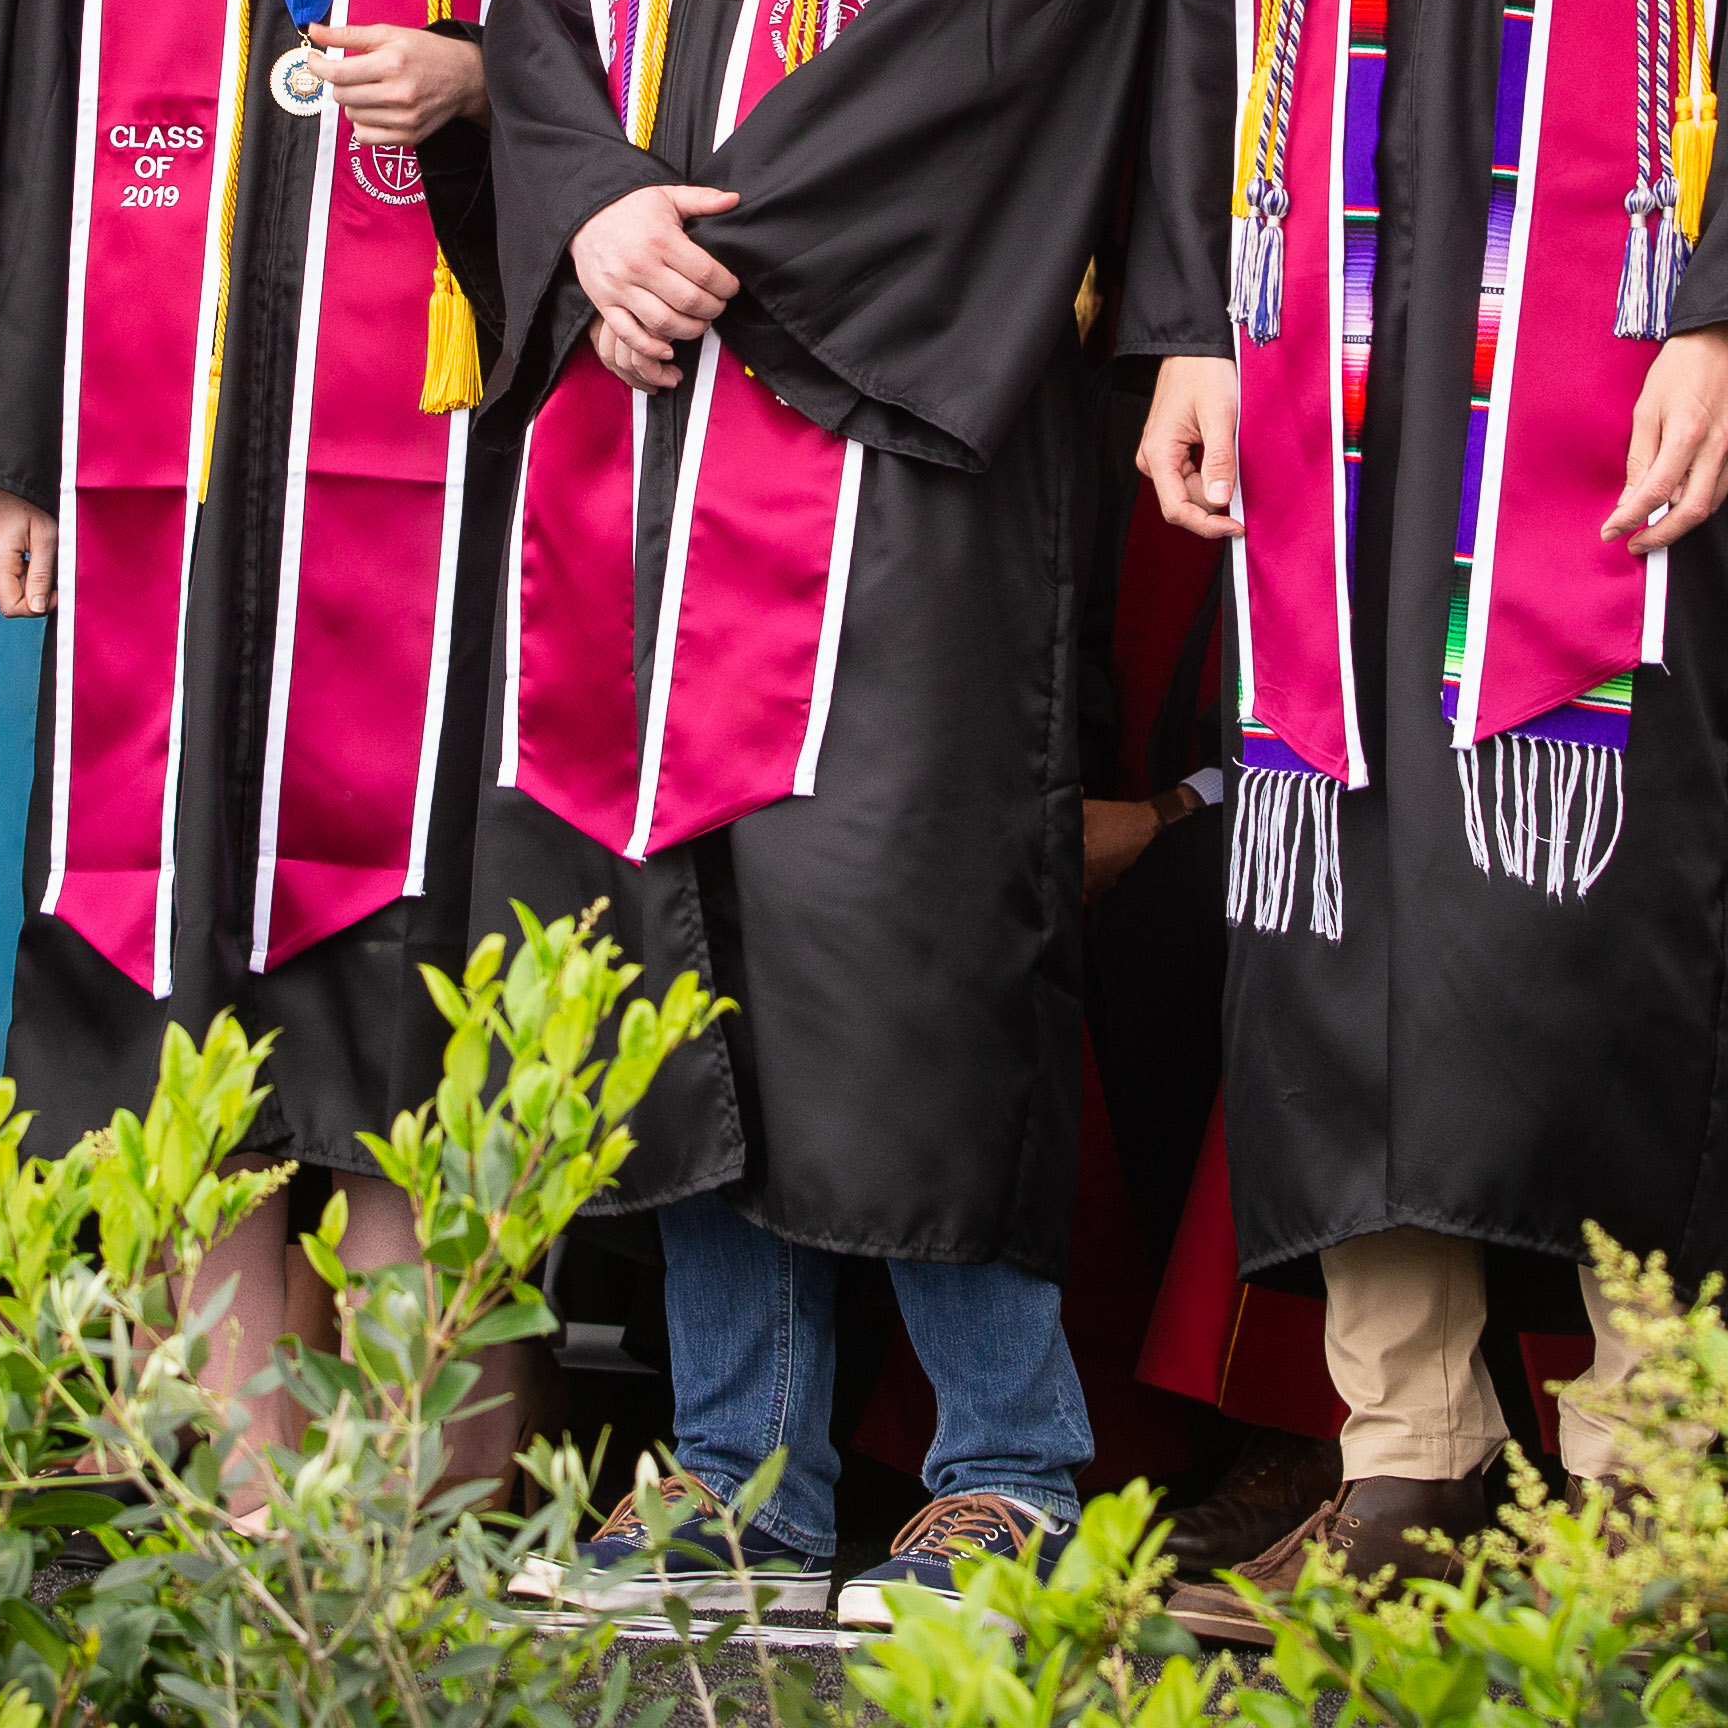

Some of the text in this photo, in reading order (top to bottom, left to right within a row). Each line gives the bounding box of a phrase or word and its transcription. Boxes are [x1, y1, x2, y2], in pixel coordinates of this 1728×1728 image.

[109, 125, 204, 149] CLASS
[134, 155, 175, 179] OF
[350, 155, 379, 197] CHRISTUS
[120, 185, 180, 207] 2019
